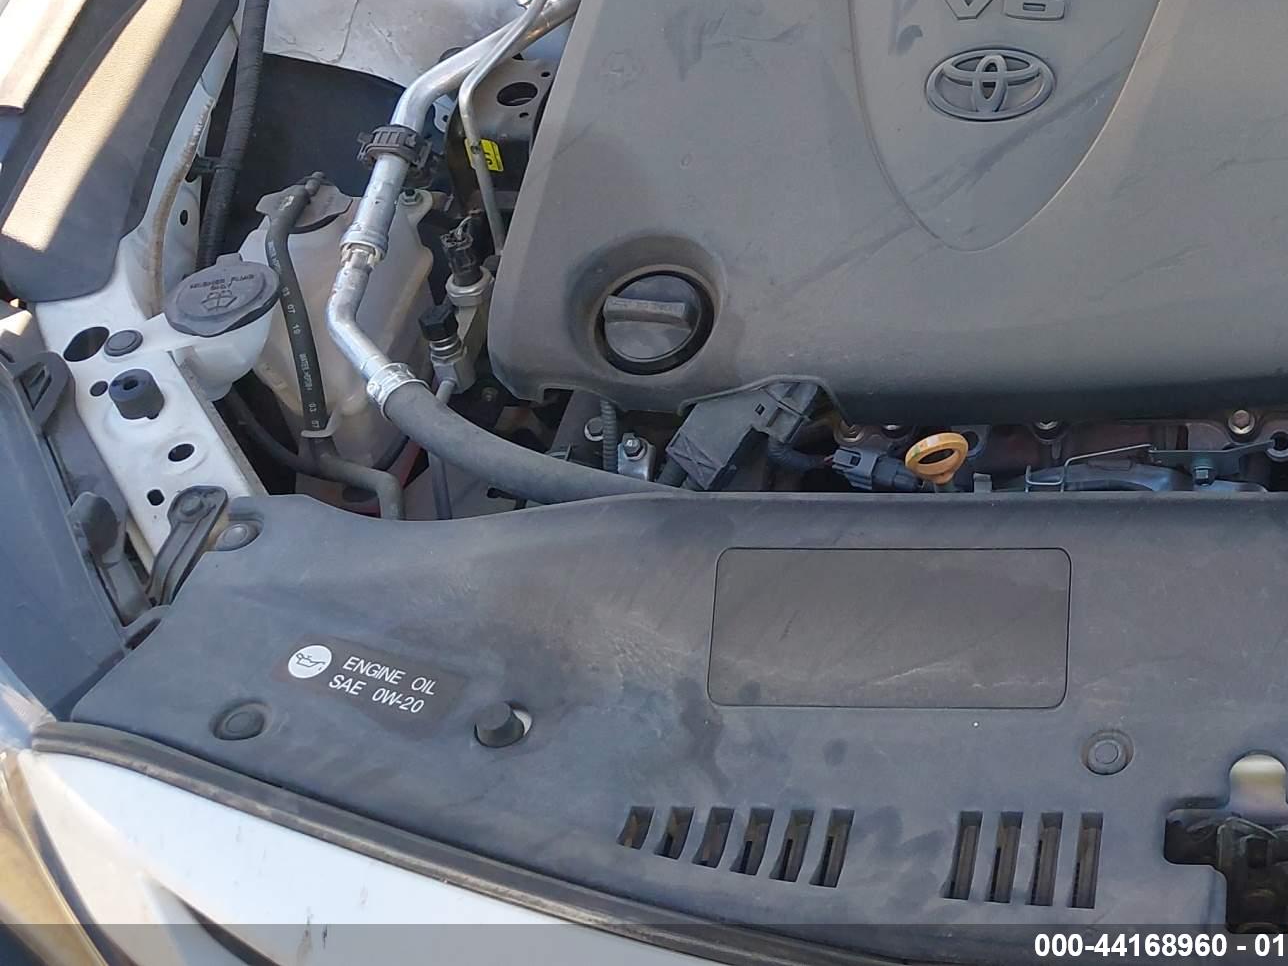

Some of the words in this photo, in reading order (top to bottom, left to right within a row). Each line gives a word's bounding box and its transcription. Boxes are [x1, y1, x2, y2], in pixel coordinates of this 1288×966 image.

[328, 674, 367, 696] SAE
[371, 687, 425, 714] 0W-20
[342, 656, 406, 684] ENGINE
[410, 676, 437, 696] OIL
